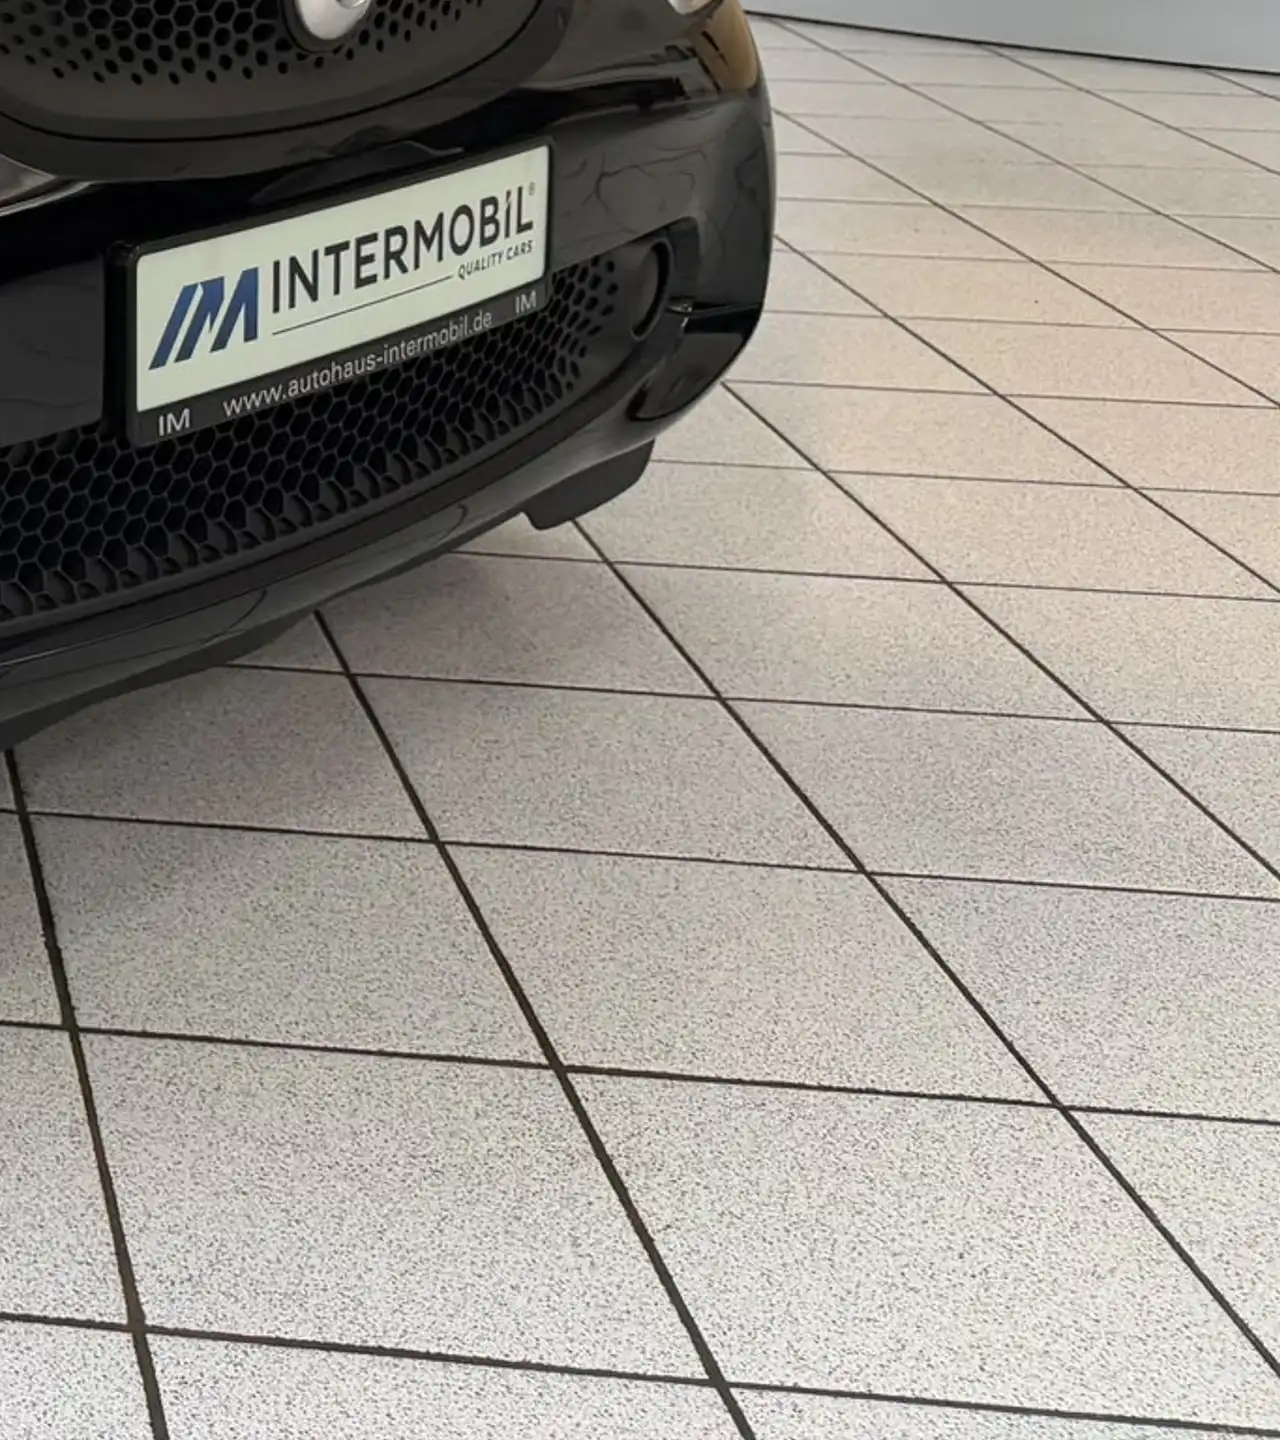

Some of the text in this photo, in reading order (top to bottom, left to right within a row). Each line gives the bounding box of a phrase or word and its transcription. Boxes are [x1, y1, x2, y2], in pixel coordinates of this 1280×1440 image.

[457, 239, 533, 280] QUALITY CARS
[158, 289, 537, 436] IM www.autohaus-intermobil.de IM
